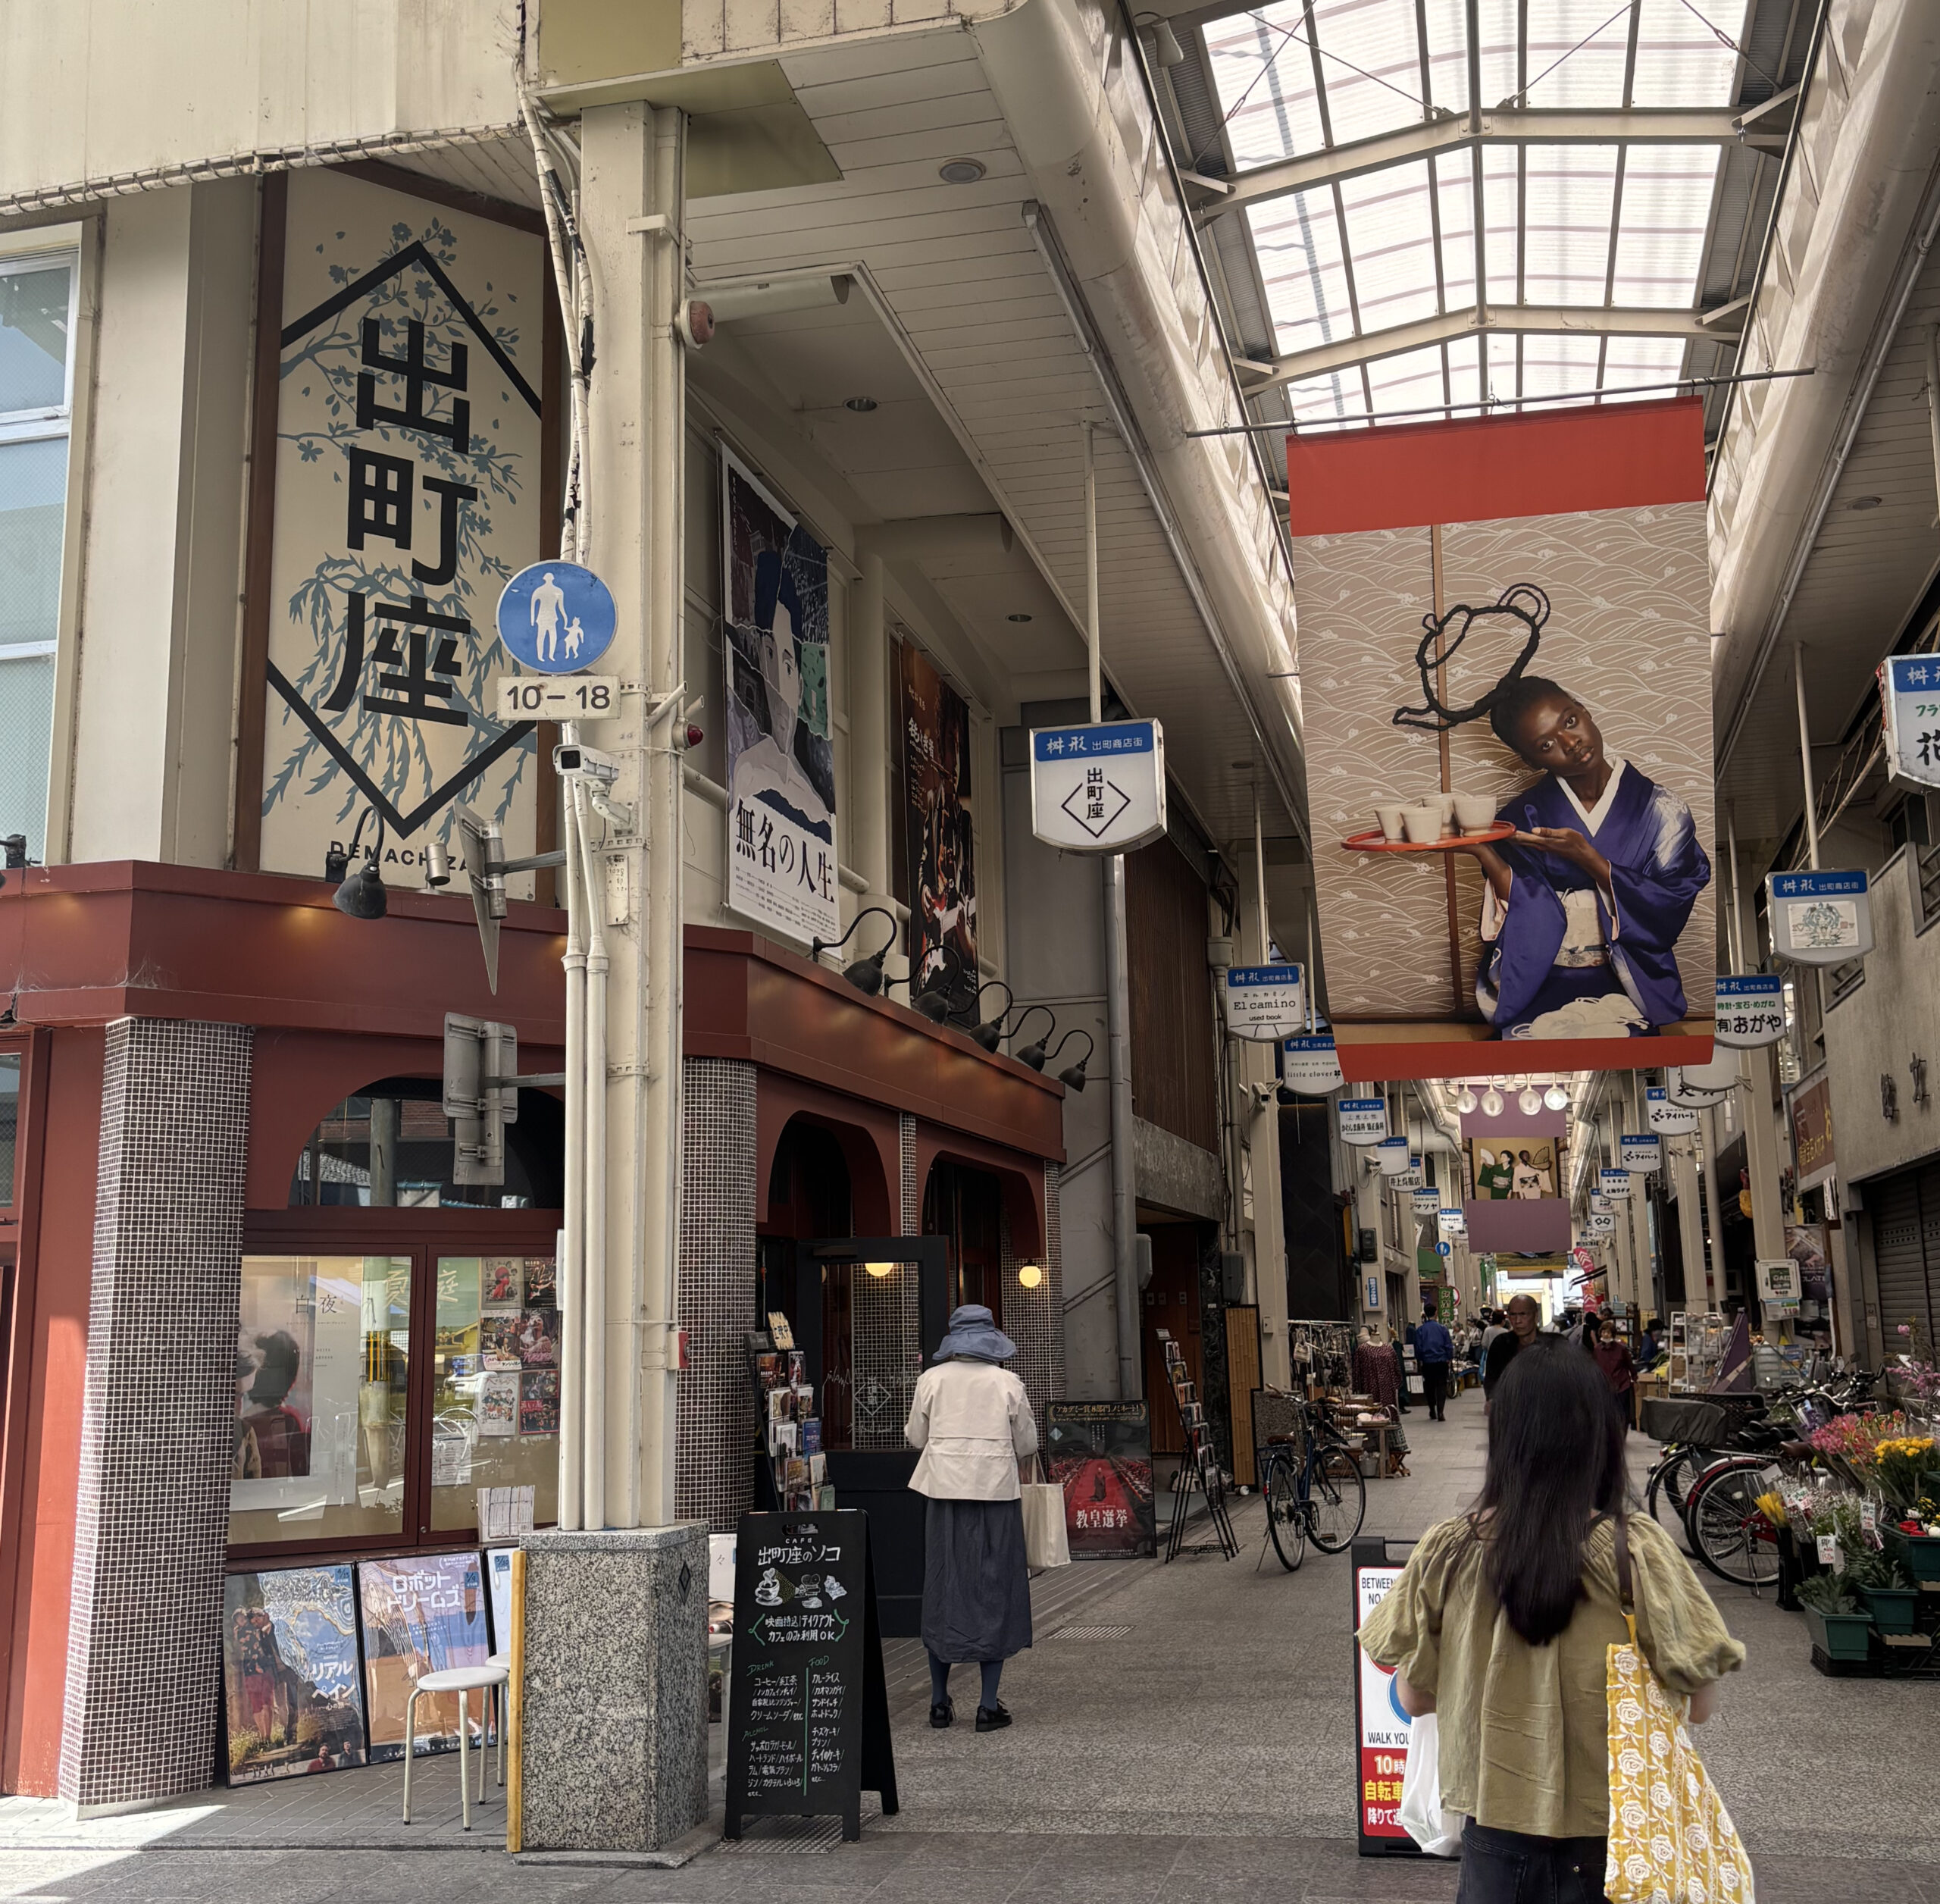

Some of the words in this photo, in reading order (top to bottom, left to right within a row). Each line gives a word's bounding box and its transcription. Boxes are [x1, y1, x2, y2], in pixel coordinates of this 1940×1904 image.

[320, 315, 478, 728] 出町座
[1092, 737, 1144, 751] 出町商店街
[1086, 767, 1104, 820] 出町座
[735, 798, 834, 903] 無名の人生
[1234, 1001, 1247, 1010] El
[1249, 999, 1296, 1010] camino
[296, 1294, 337, 1314] 白夜
[1075, 1508, 1128, 1529] 教皇選挙
[758, 1545, 841, 1566] 出町座のソコ
[393, 1569, 451, 1593] ロボット
[387, 1583, 461, 1613] ドリームズ
[746, 1660, 774, 1677] DRINK
[809, 1655, 830, 1668] FOOD
[812, 1672, 840, 1683] カレーライス
[1368, 1732, 1392, 1744] WALK
[1365, 1780, 1403, 1802] 自転車
